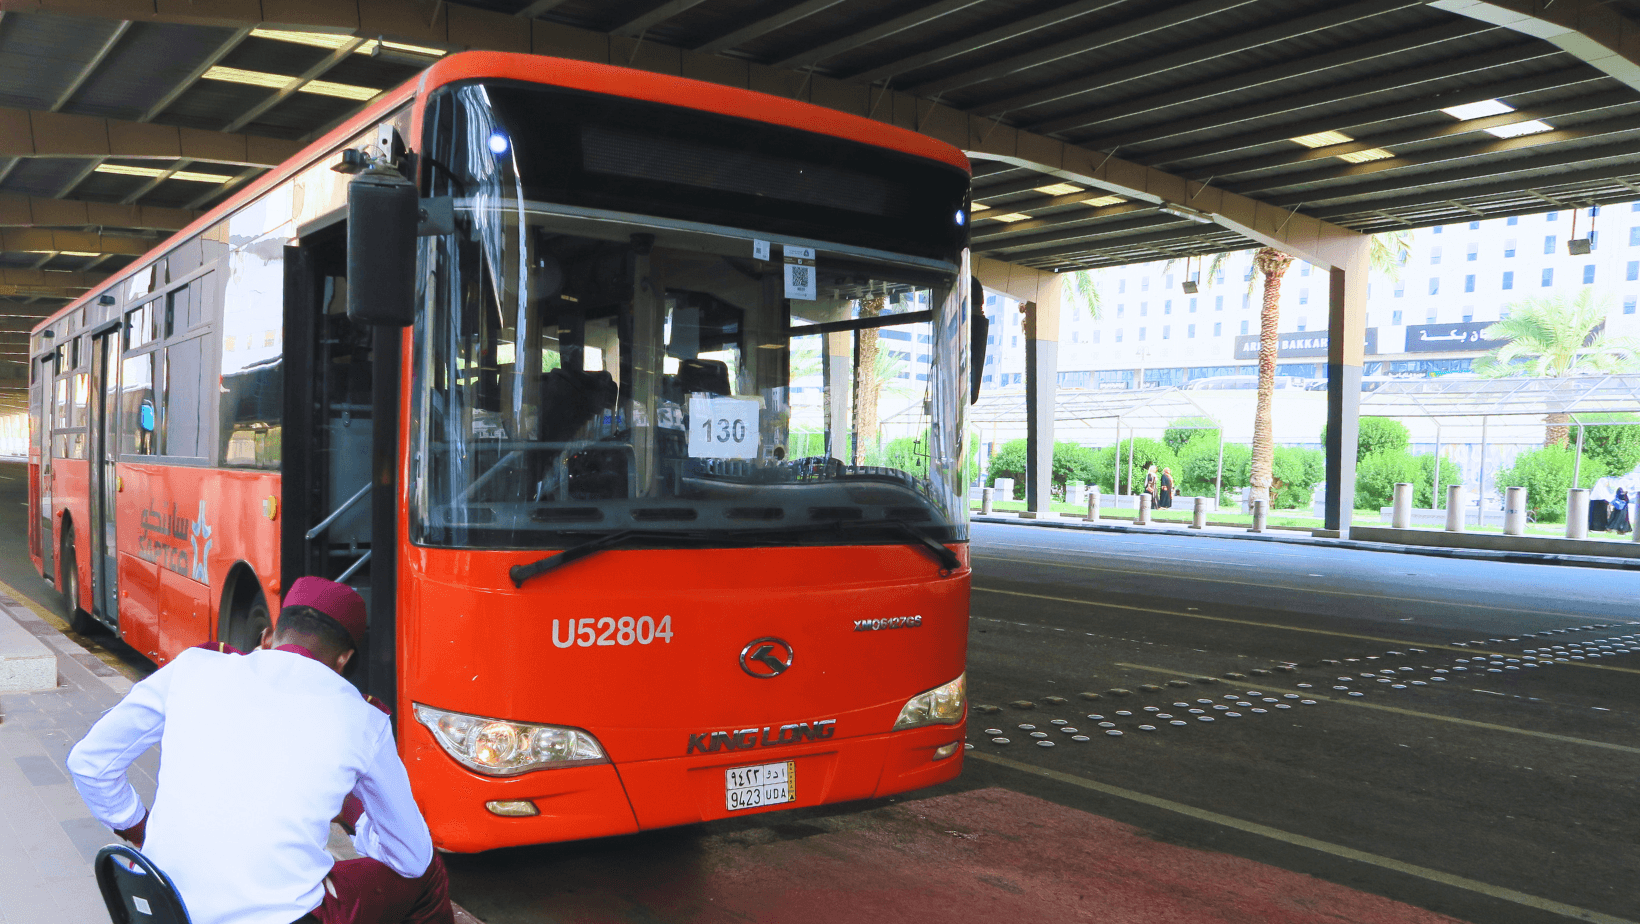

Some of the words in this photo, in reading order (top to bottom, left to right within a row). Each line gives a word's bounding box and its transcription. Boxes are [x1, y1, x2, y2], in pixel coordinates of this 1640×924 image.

[702, 418, 746, 443] 130
[552, 615, 674, 648] U52804
[686, 727, 760, 755] KING
[760, 718, 837, 747] LONG
[731, 788, 761, 809] 9423
[765, 787, 787, 801] UDA
